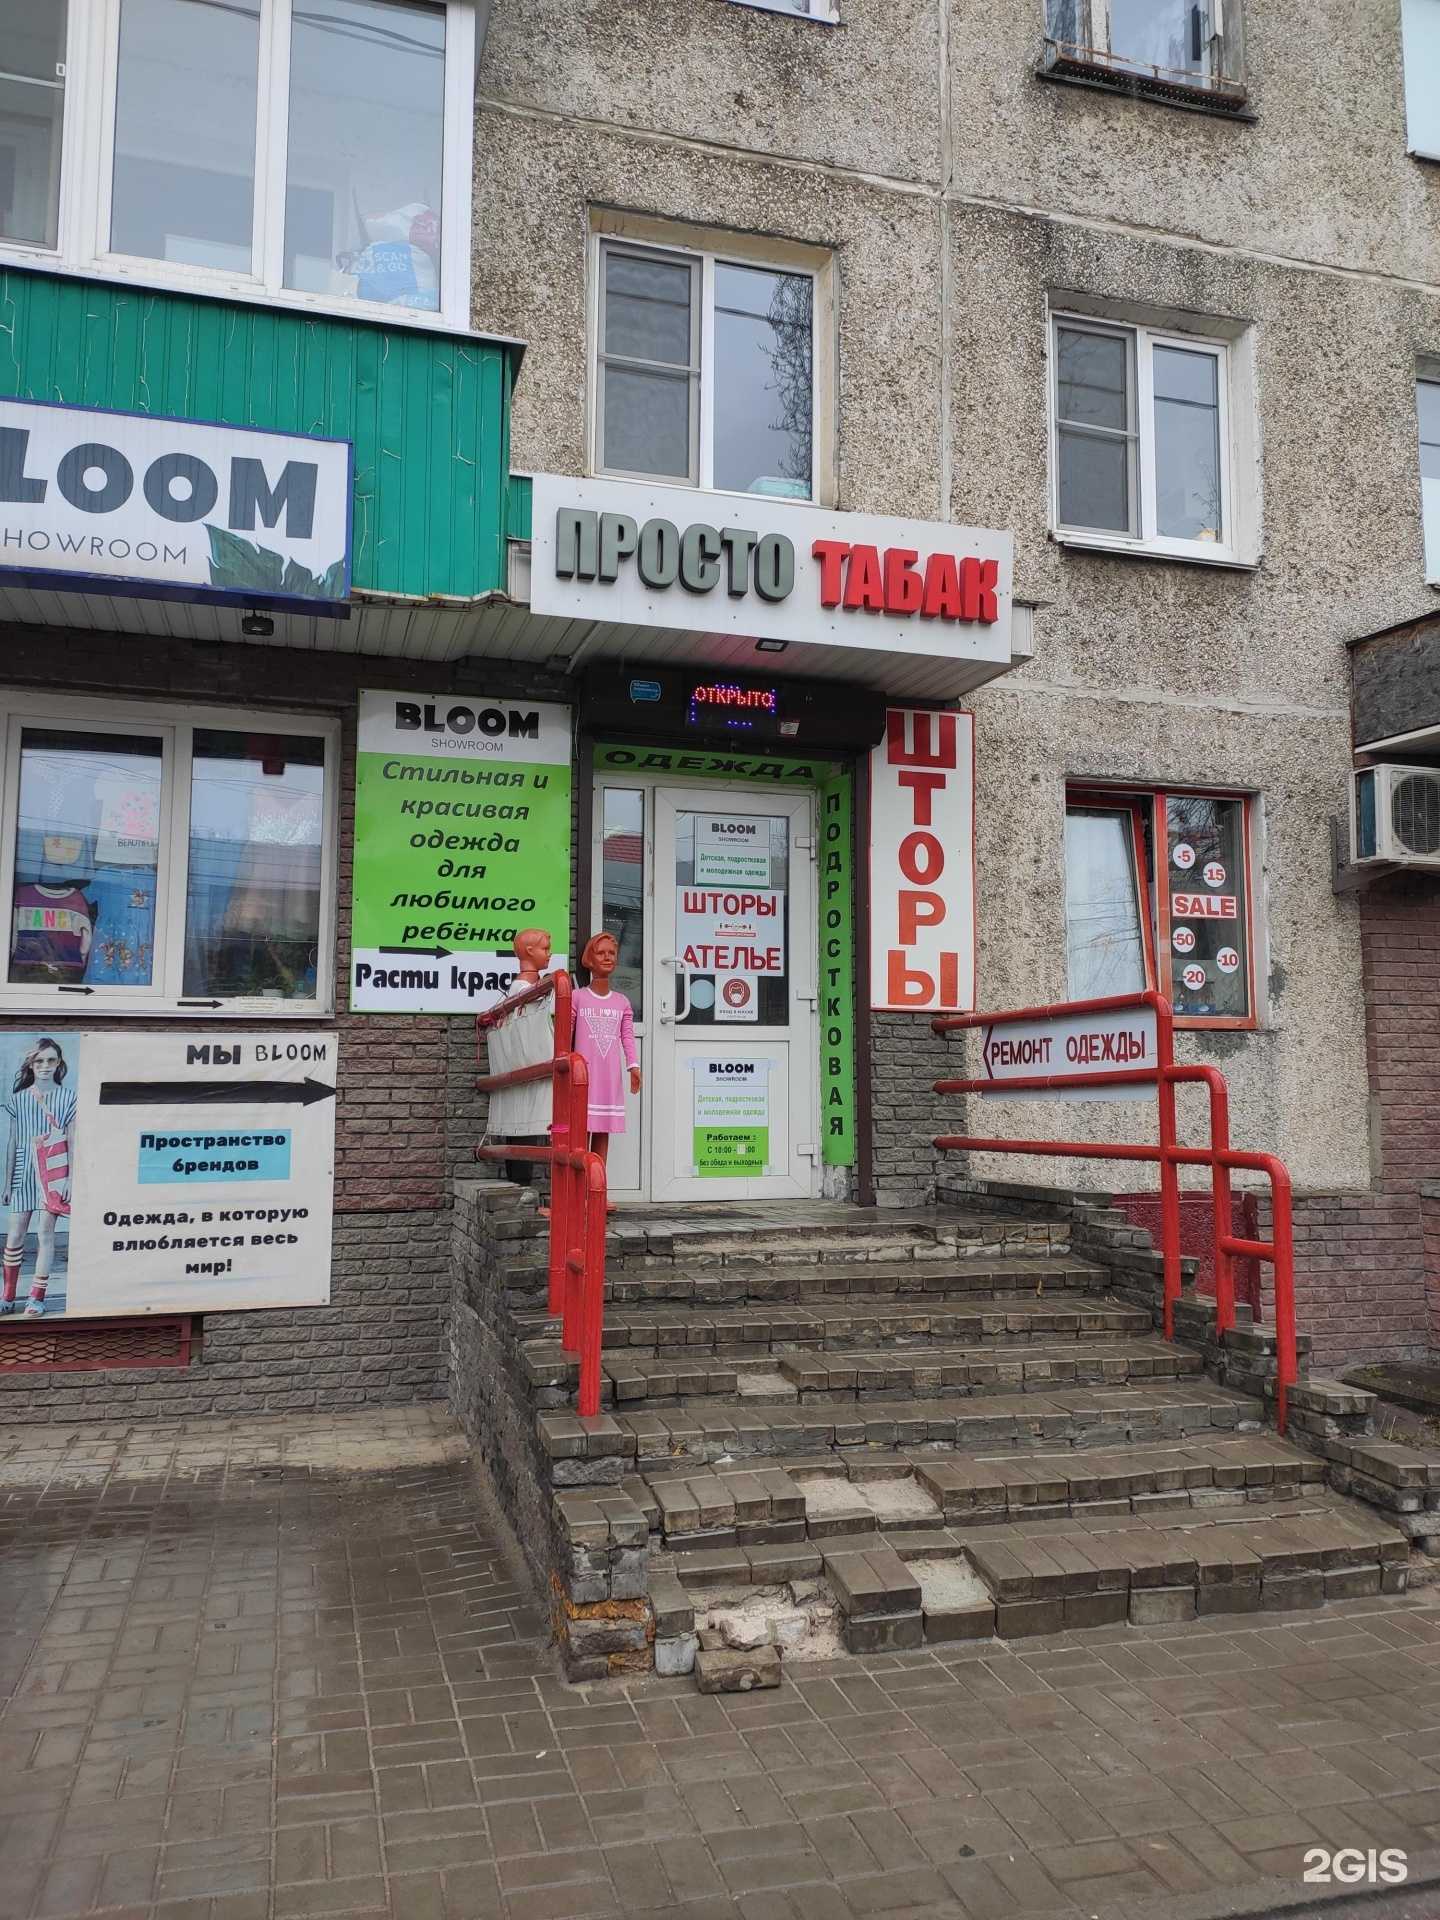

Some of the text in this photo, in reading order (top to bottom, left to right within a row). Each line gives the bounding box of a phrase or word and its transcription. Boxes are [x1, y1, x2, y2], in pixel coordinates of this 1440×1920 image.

[555, 507, 998, 624] ПРОСТО ТАБАК
[694, 686, 775, 708] ОТКРЫТО
[395, 701, 540, 740] BLOOM
[431, 738, 504, 752] SHOWROOM
[605, 750, 815, 778] ОДЕЖДА
[382, 760, 549, 790] Стильная и
[400, 799, 530, 821] красивая
[711, 822, 756, 835] BLOOM
[410, 829, 520, 853] одежда
[887, 711, 958, 1008] ШТОРЫ
[1177, 850, 1191, 863] -5
[437, 859, 487, 880] для
[1203, 868, 1225, 881] -15
[390, 890, 536, 912] любимого
[683, 891, 777, 917] ШТОРЫ
[1174, 895, 1235, 917] SALE
[401, 921, 517, 944] ребёнка
[1172, 933, 1195, 946] -50
[680, 944, 782, 971] АТЕЛЬЕ
[826, 792, 844, 1136] ПОДРОСТКОВАЯ
[1217, 954, 1238, 967] -10
[355, 963, 514, 997] Расти крас
[1183, 971, 1205, 983] -20
[185, 1044, 327, 1065] МЫ BLOOM
[991, 1030, 1145, 1066] РЕМОНТ ОДЕЖДЫ
[709, 1063, 755, 1073] BLOOM
[140, 1134, 286, 1151] Пространство
[706, 1133, 751, 1141] Работаем
[172, 1158, 259, 1175] брендов
[103, 1206, 309, 1227] Одежда, в которую
[112, 1232, 298, 1252] влюбляется весь
[185, 1258, 232, 1275] мир!
